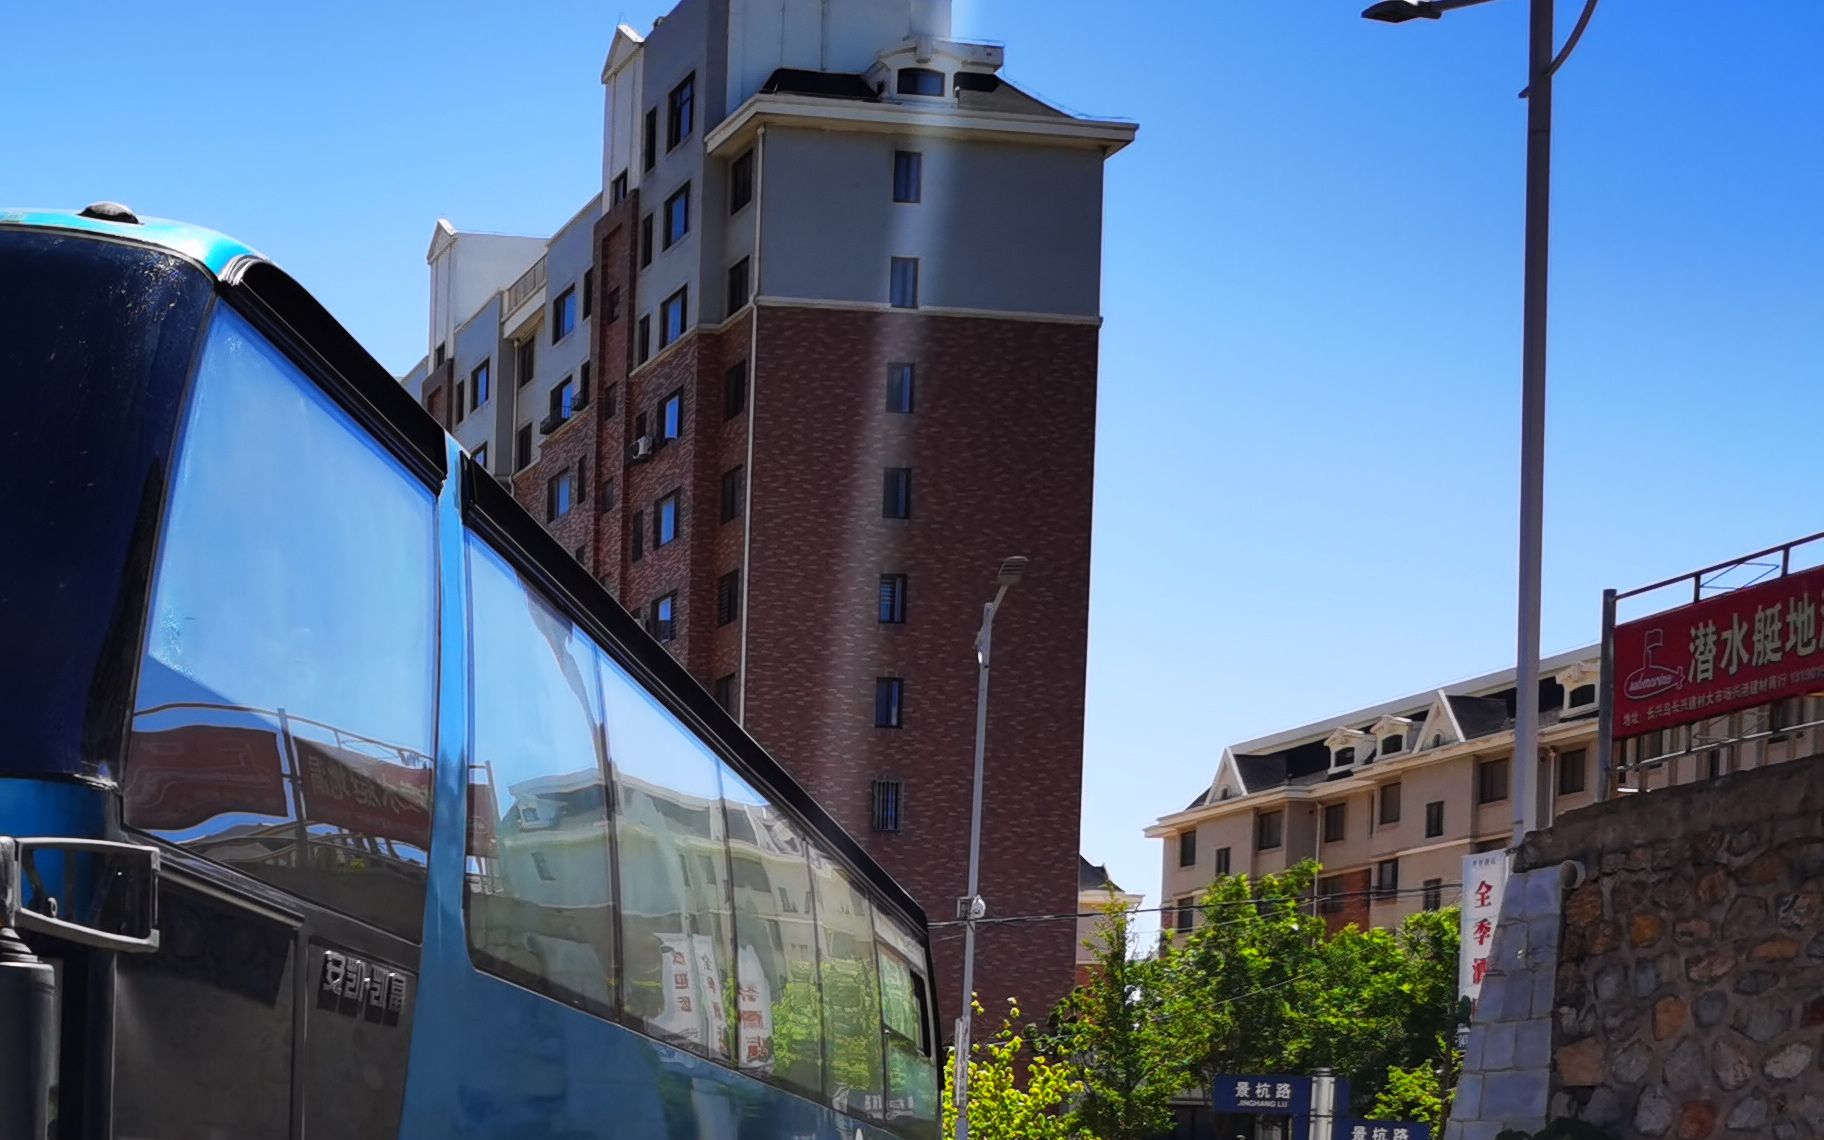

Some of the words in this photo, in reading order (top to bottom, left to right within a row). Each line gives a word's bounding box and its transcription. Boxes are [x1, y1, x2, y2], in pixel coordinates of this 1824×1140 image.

[1688, 591, 1824, 684] 潜水艇地
[1235, 1081, 1292, 1099] 景杭路
